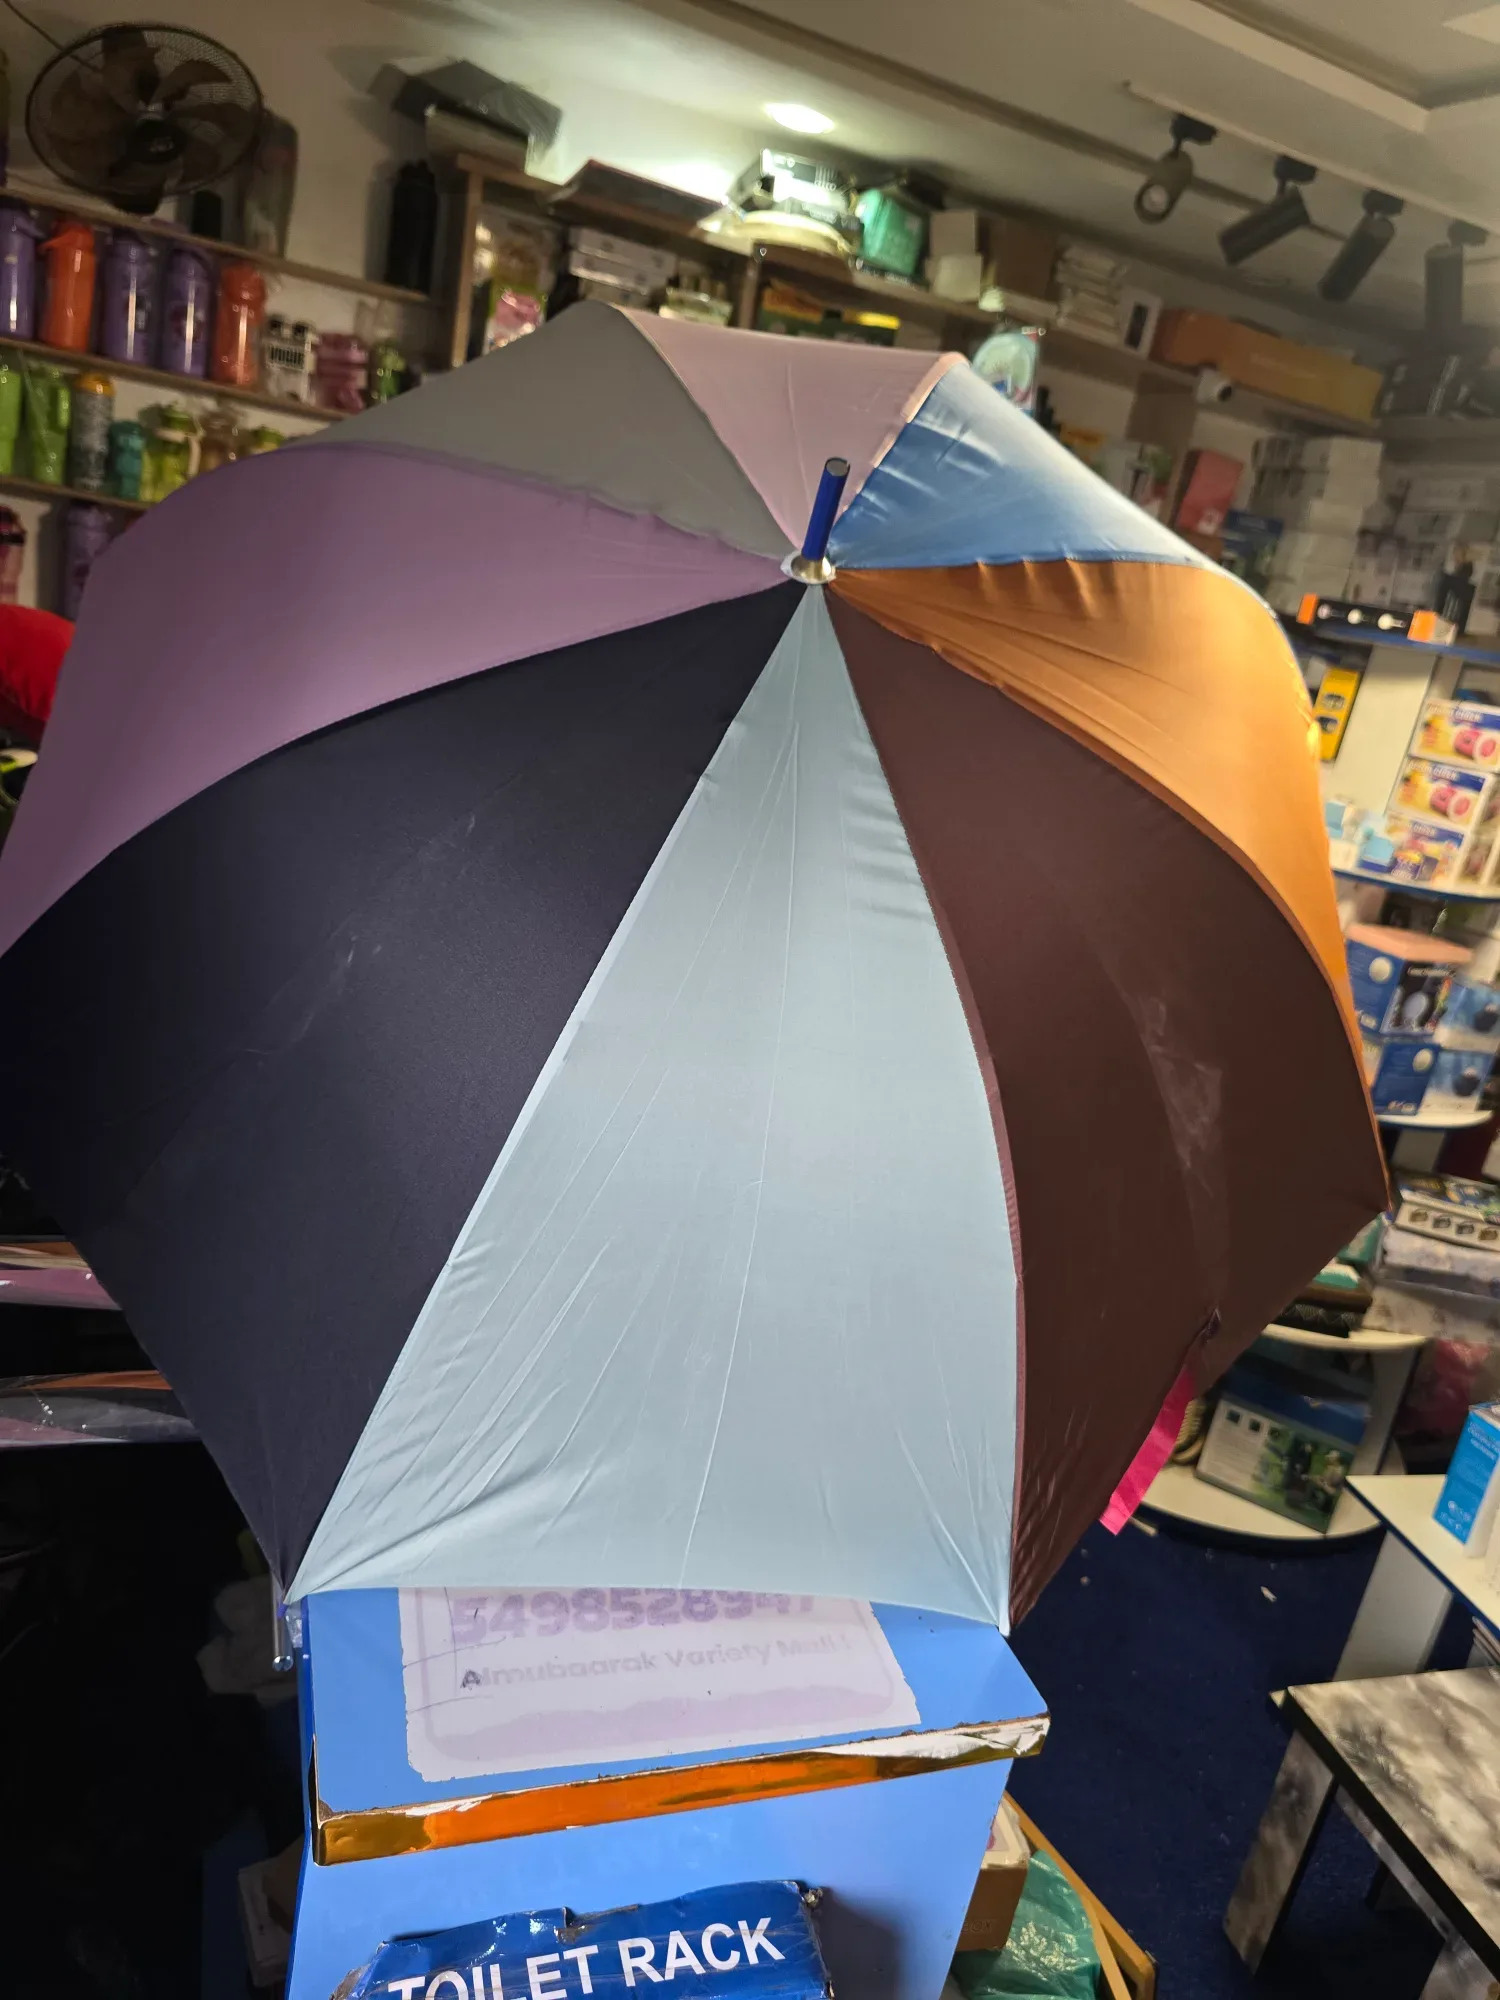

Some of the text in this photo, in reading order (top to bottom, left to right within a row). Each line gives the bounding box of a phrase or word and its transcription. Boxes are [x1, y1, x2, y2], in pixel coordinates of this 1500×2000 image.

[460, 1652, 658, 1689] Almubaarak
[664, 1643, 770, 1668] Variety
[388, 1917, 786, 2000] TOILET RACK
